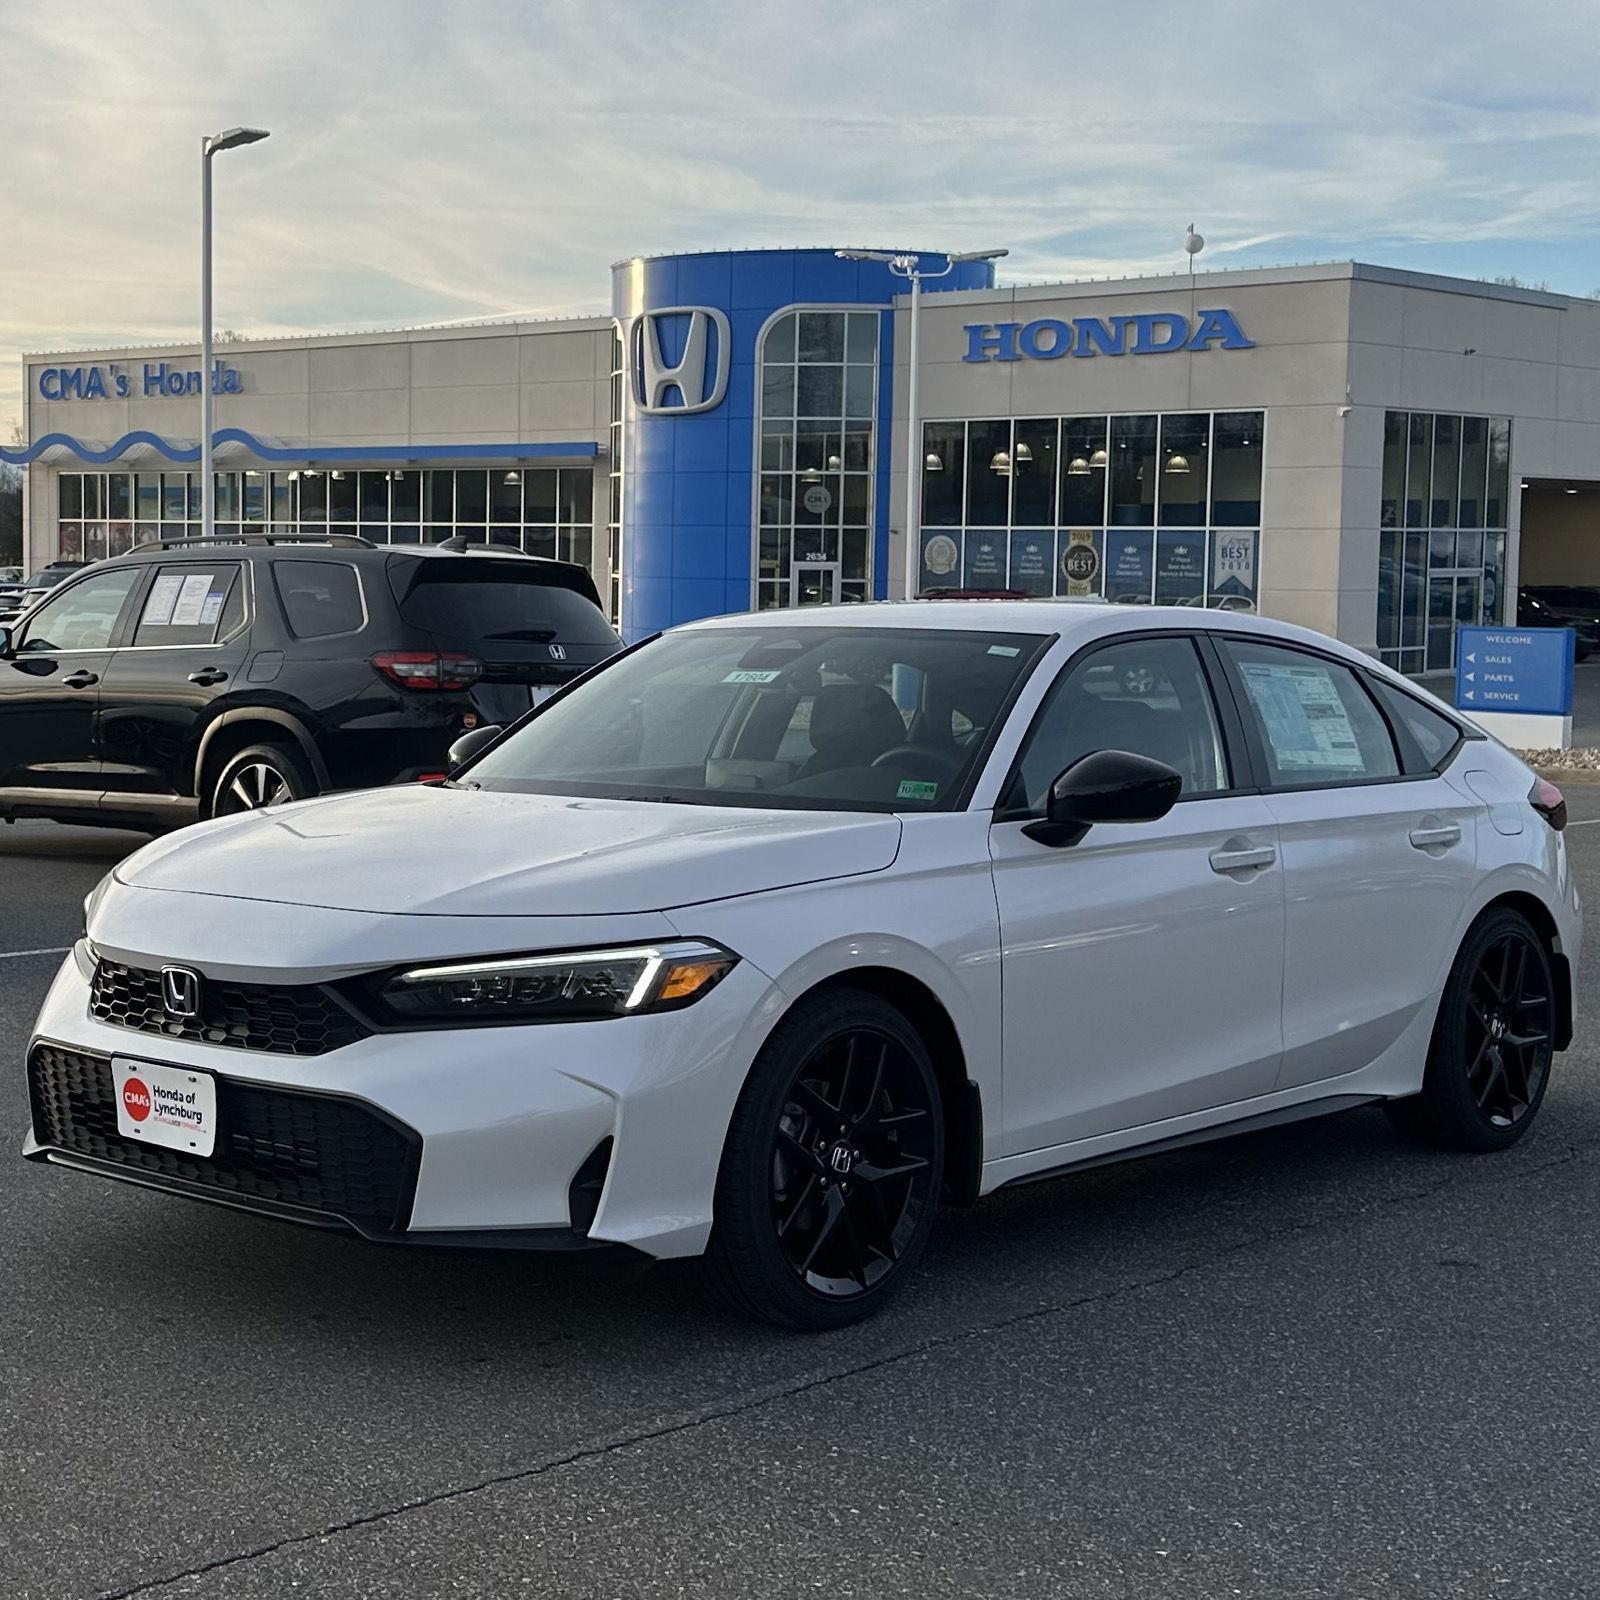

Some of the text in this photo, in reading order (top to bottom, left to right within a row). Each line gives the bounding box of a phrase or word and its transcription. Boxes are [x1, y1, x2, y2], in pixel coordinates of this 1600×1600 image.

[961, 308, 1256, 363] HONDA
[39, 360, 243, 400] CMA's Honda
[1221, 547, 1250, 558] BEST
[1067, 559, 1093, 571] BEST
[1486, 635, 1533, 645] WELCOME
[1484, 655, 1512, 664] SALES
[1484, 674, 1514, 683] PARTS
[1484, 692, 1520, 701] SERVICE
[152, 1084, 196, 1105] Honda of
[153, 1100, 203, 1124] Lynchburg
